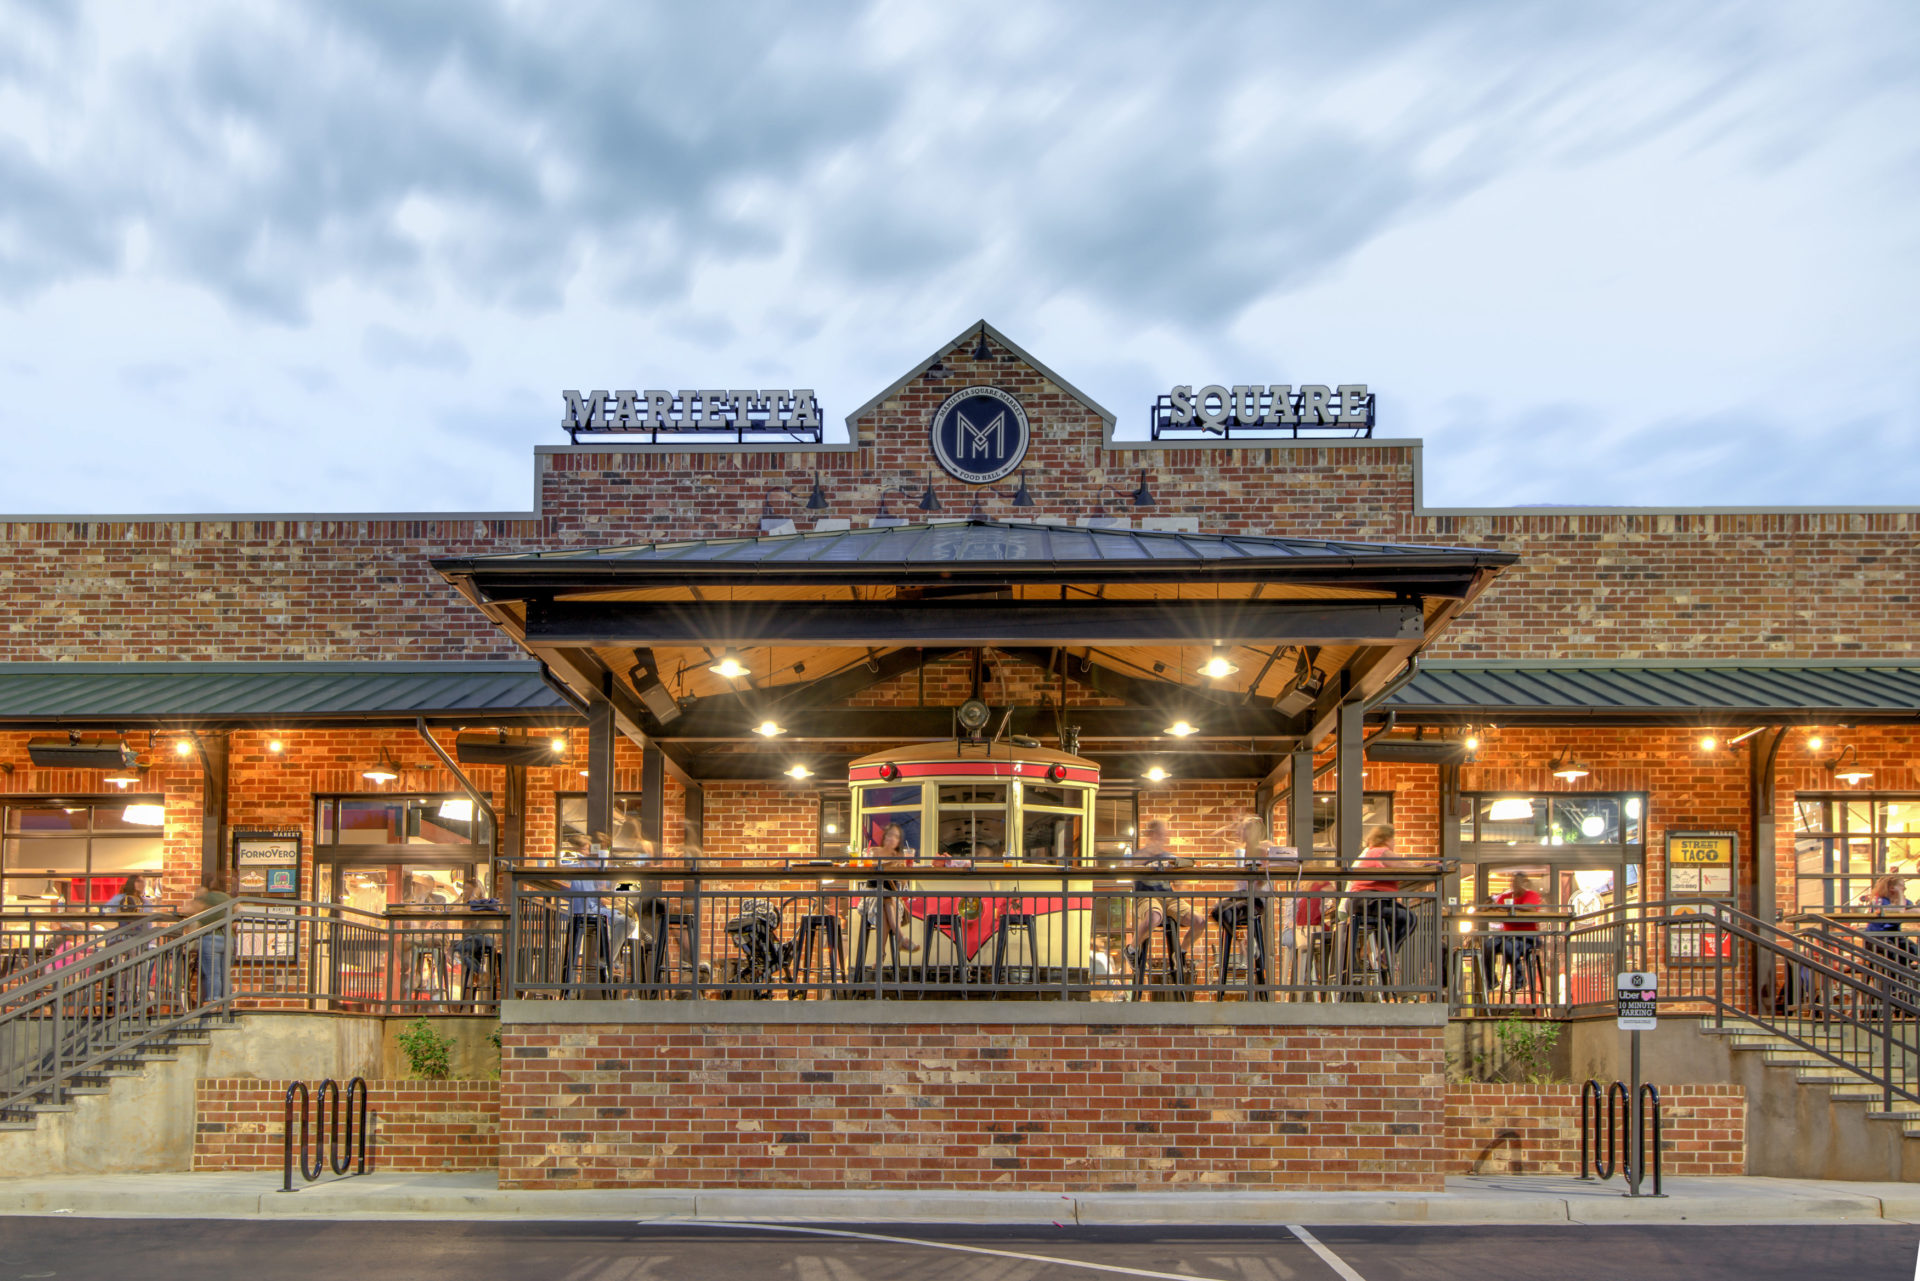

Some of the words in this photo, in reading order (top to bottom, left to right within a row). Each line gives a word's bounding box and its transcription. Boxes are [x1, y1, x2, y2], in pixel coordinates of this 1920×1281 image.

[940, 391, 970, 417] MARIETTA
[970, 387, 998, 397] SQUARE
[999, 392, 1023, 417] MARKET
[561, 389, 819, 428] MARIETTA
[1170, 384, 1367, 435] SQUARE
[959, 471, 980, 481] FOOD
[982, 472, 1001, 481] HALL
[1681, 850, 1719, 861] TACO
[1618, 990, 1640, 999] Uber
[1628, 1001, 1656, 1009] MINUTE
[1621, 1009, 1653, 1017] PARKING
